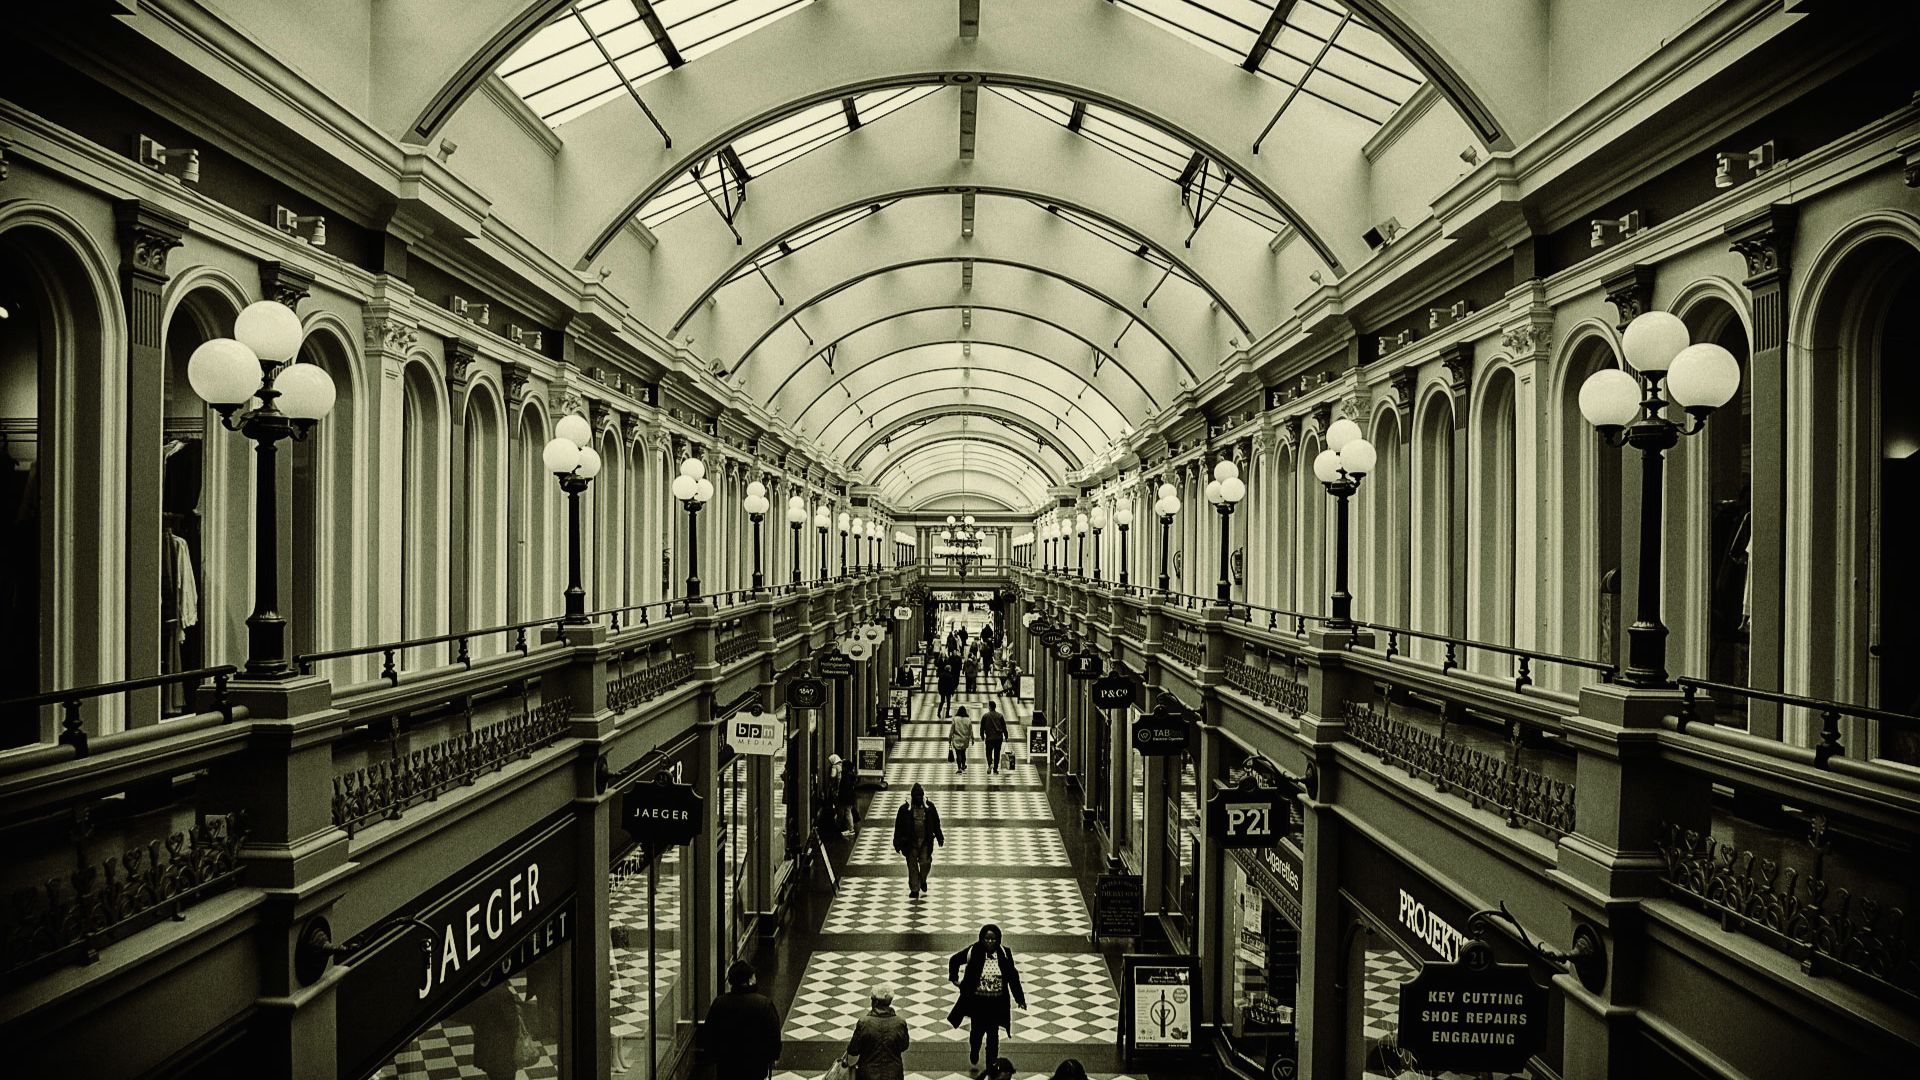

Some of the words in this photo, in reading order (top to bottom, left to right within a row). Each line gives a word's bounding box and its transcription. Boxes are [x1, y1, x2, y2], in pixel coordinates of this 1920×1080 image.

[736, 723, 775, 738] bpm
[634, 808, 689, 820] JAEGER
[1226, 808, 1271, 836] P21
[419, 863, 540, 999] JAEGER
[1398, 888, 1469, 963] PROJEKT
[1428, 991, 1455, 1003] KEY
[1462, 992, 1524, 1006] CUTTING
[1421, 1010, 1459, 1024] SHOE
[1466, 1012, 1528, 1025] REPAIRS
[1432, 1031, 1515, 1045] ENGRAVING
